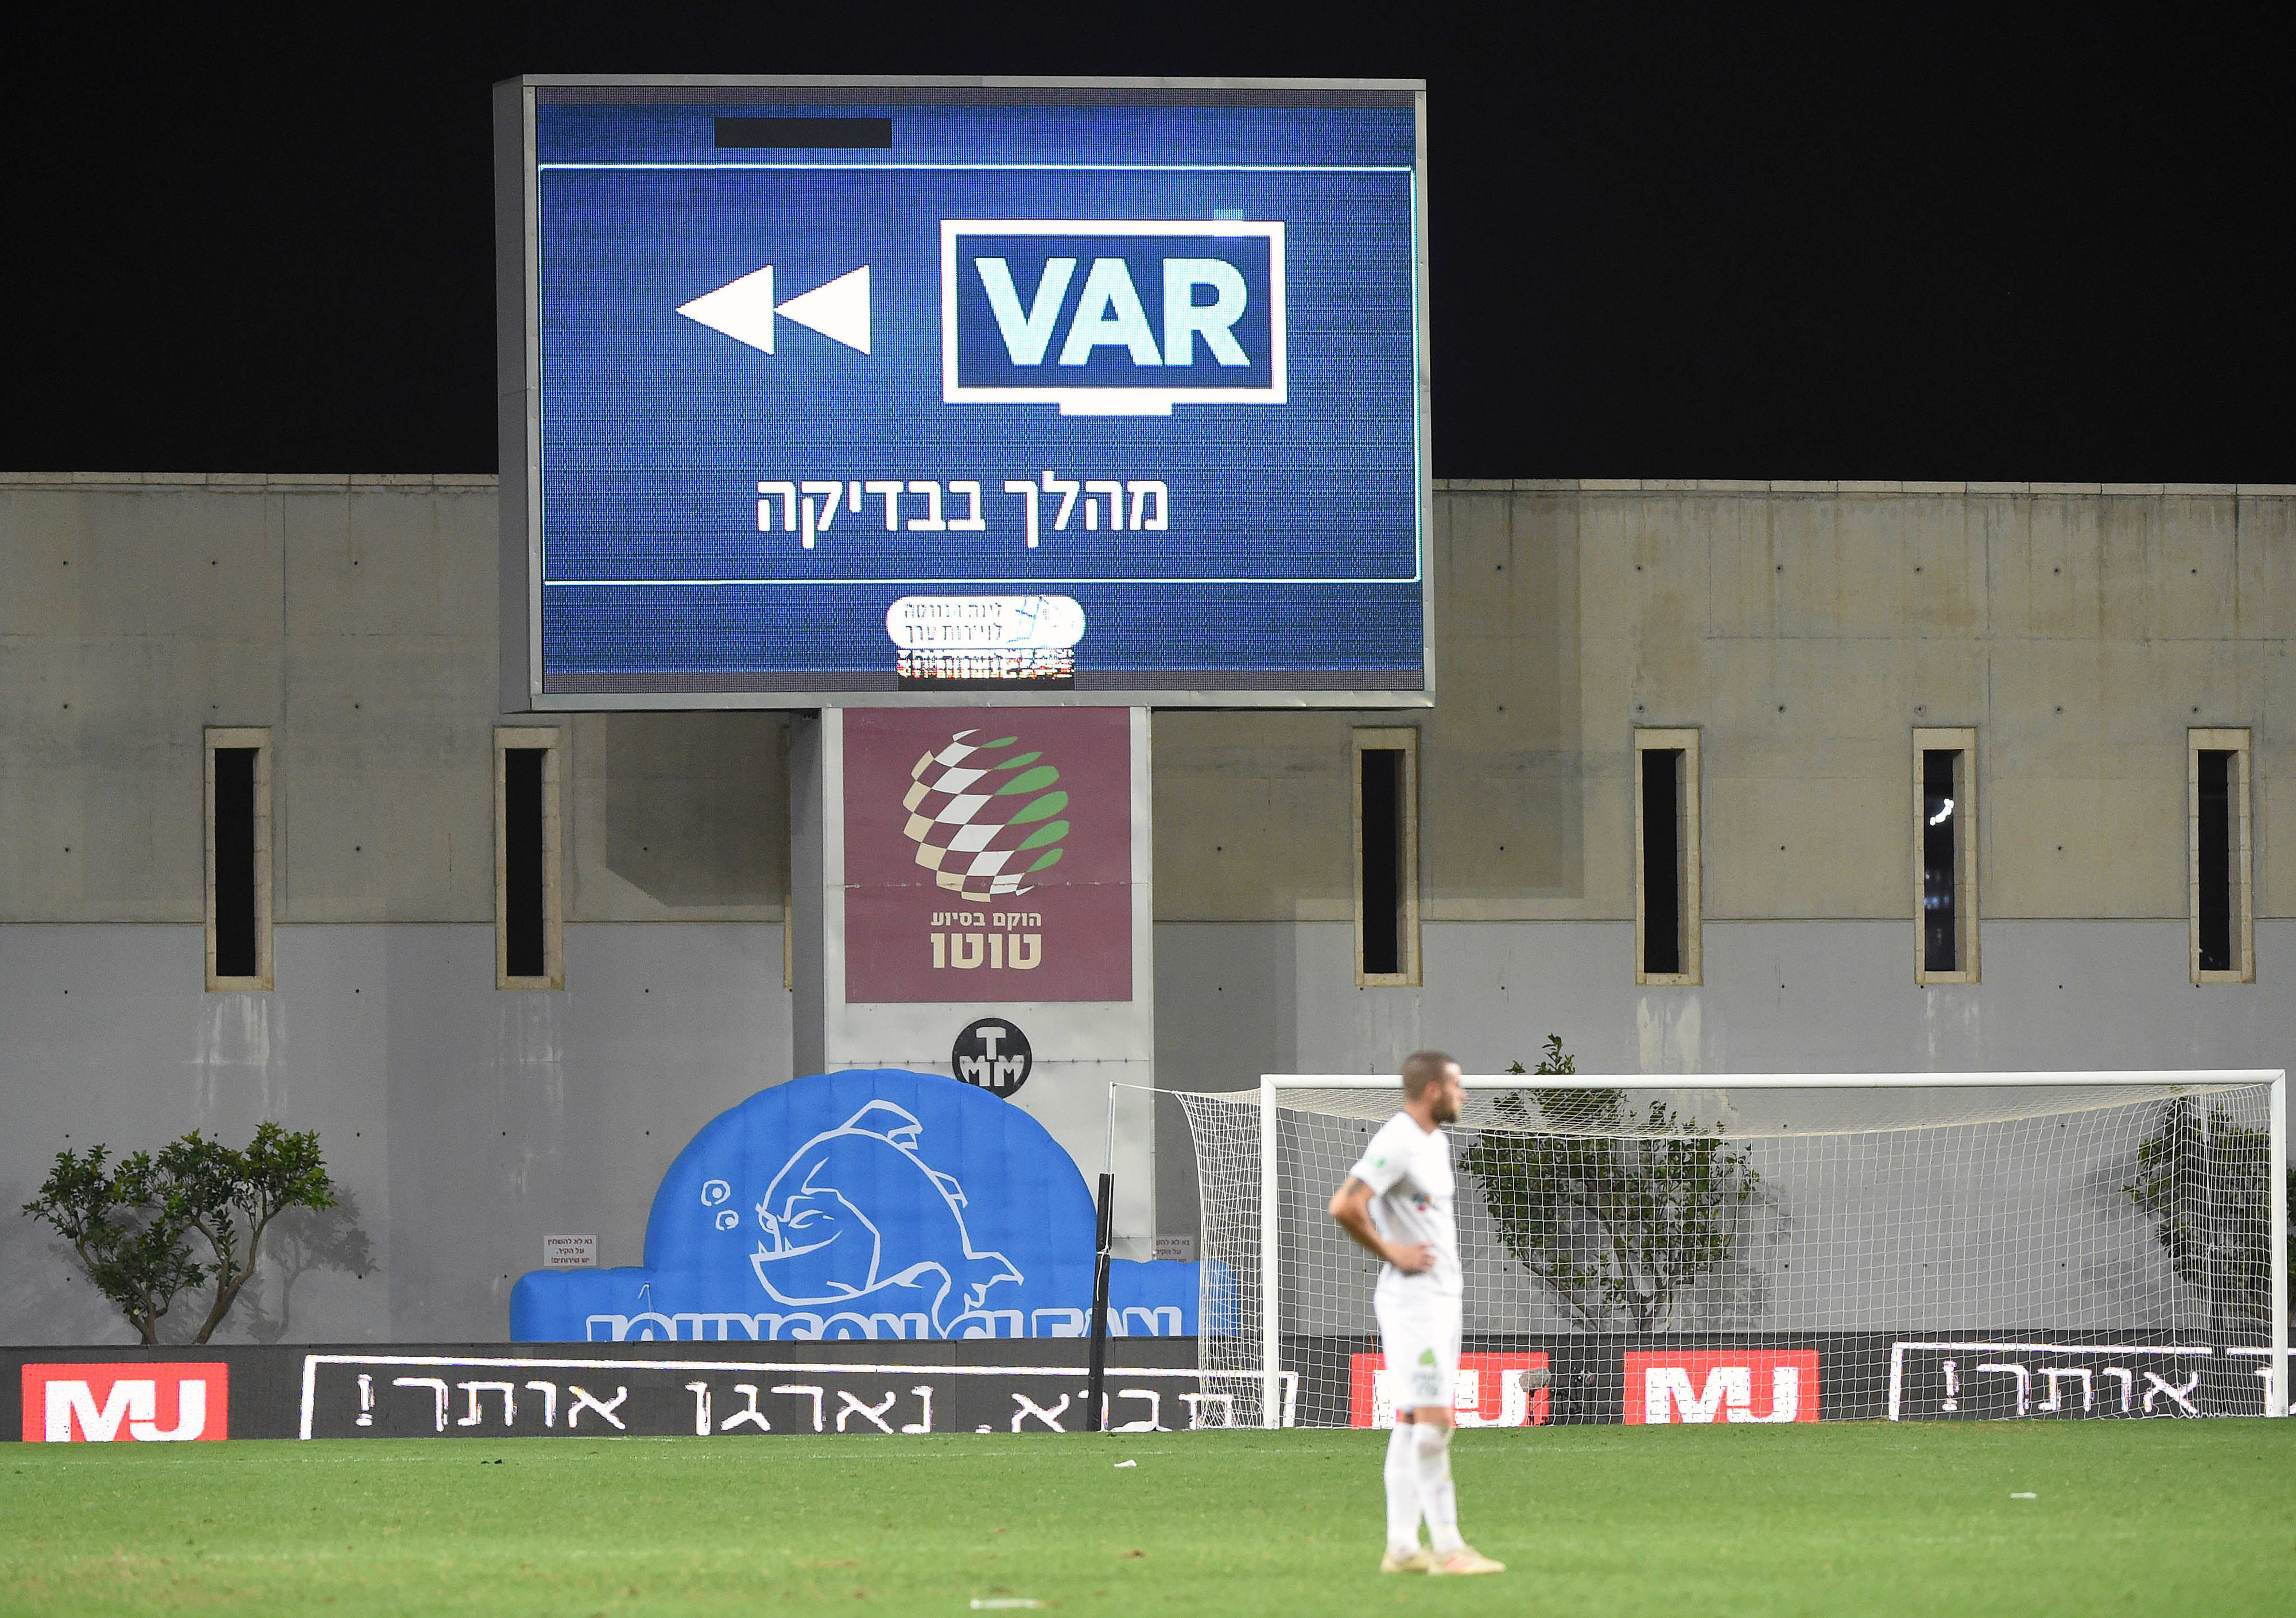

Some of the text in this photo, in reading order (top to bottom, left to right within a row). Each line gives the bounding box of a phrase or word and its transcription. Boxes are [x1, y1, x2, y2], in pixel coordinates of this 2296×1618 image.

[973, 257, 1251, 367] VAR
[757, 470, 1168, 549] מהלך בבדיקה
[930, 912, 1042, 931] הוקם בסיוע
[930, 933, 1042, 970] טוטו
[547, 1238, 572, 1246] להשתין
